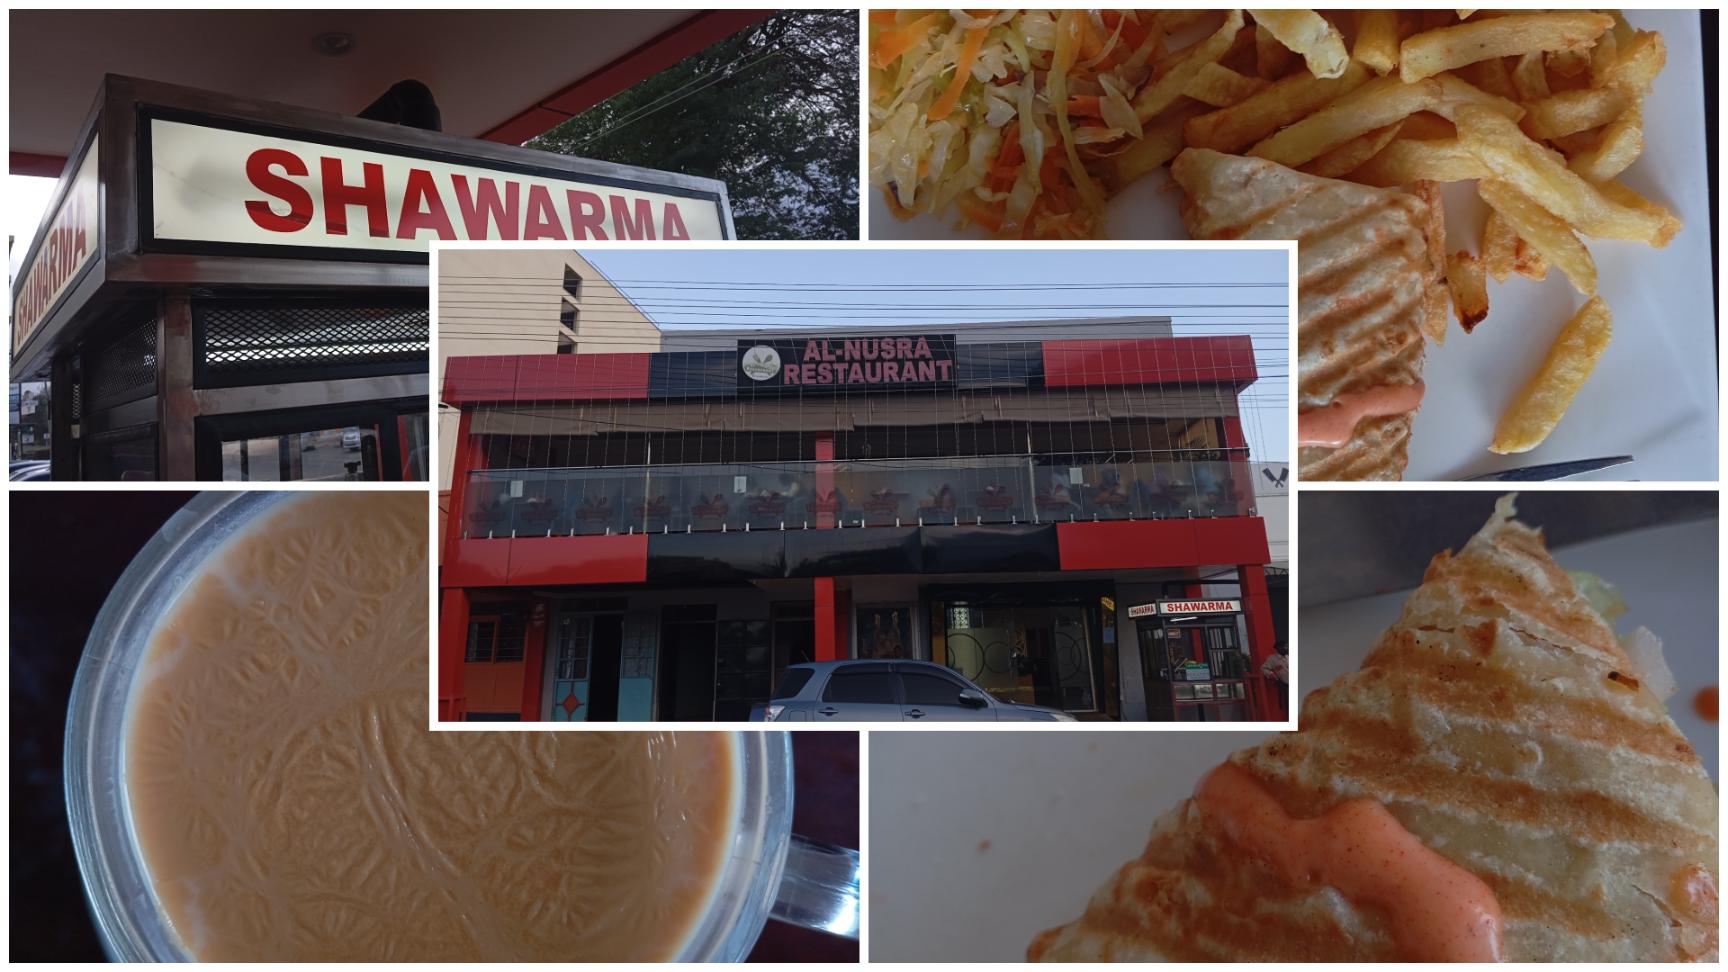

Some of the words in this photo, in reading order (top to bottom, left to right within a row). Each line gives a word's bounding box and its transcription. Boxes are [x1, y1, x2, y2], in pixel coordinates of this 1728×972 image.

[245, 148, 691, 240] SHAWARMA
[17, 190, 87, 346] SHAWARMA
[803, 337, 932, 361] AL-NUSRA
[784, 360, 952, 384] RESTAURANT
[1167, 602, 1233, 612] SHAWARMA
